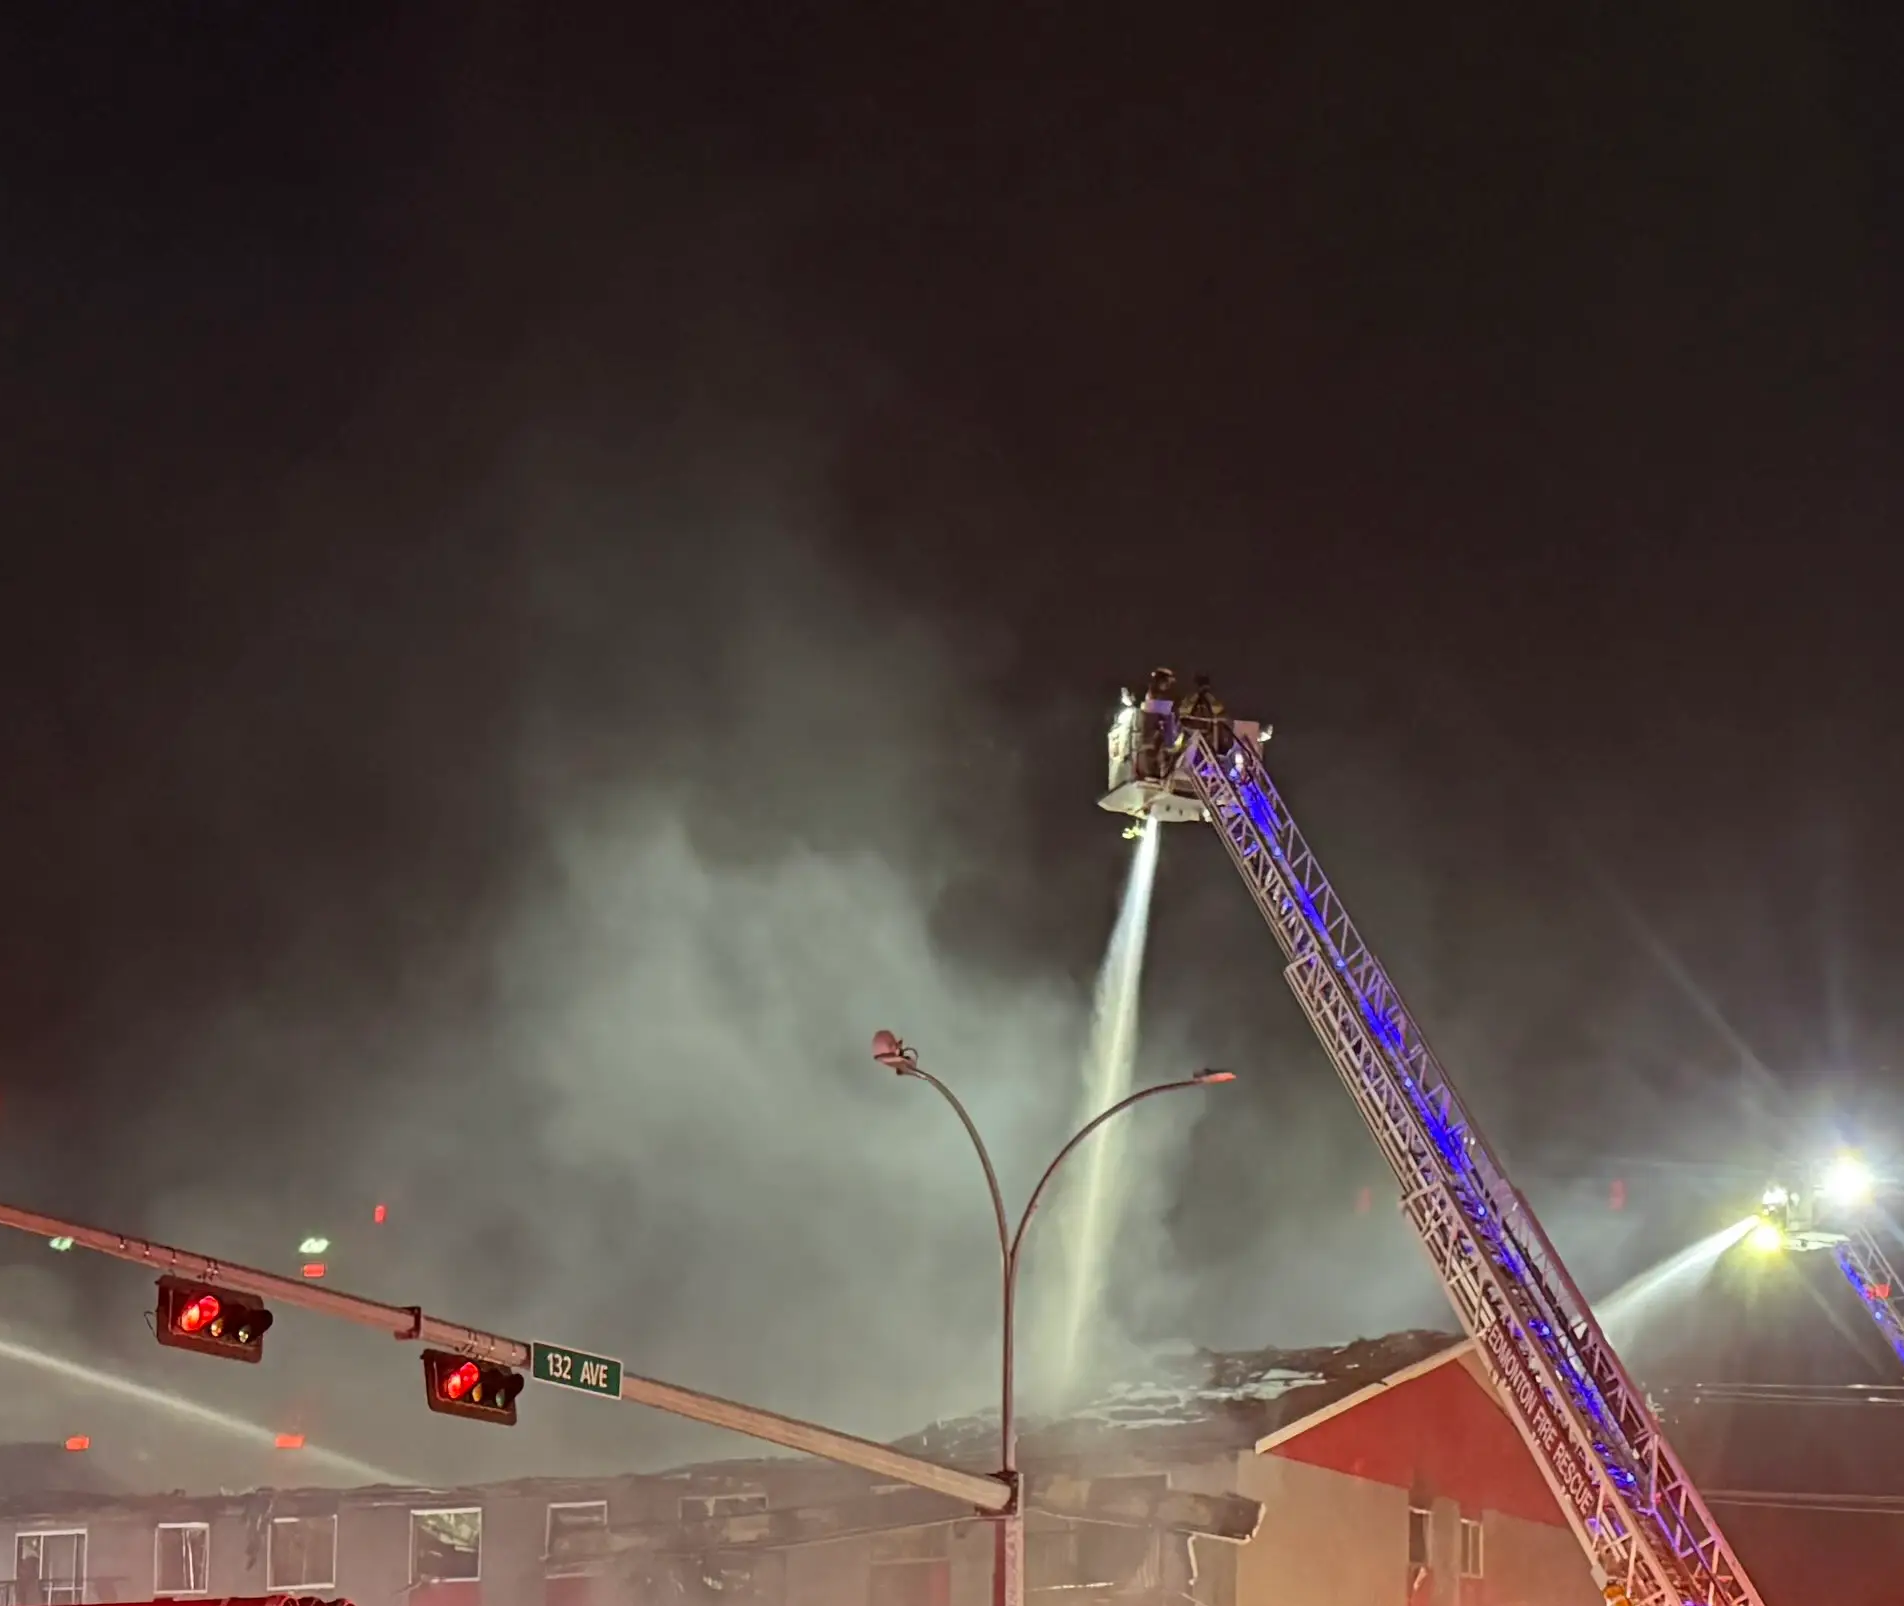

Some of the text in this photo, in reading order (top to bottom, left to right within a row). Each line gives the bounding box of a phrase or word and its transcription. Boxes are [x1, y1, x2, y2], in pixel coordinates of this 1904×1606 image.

[547, 1352, 608, 1388] 132 AVE
[1487, 1326, 1595, 1516] EDMONTON FIRE RESCUE
